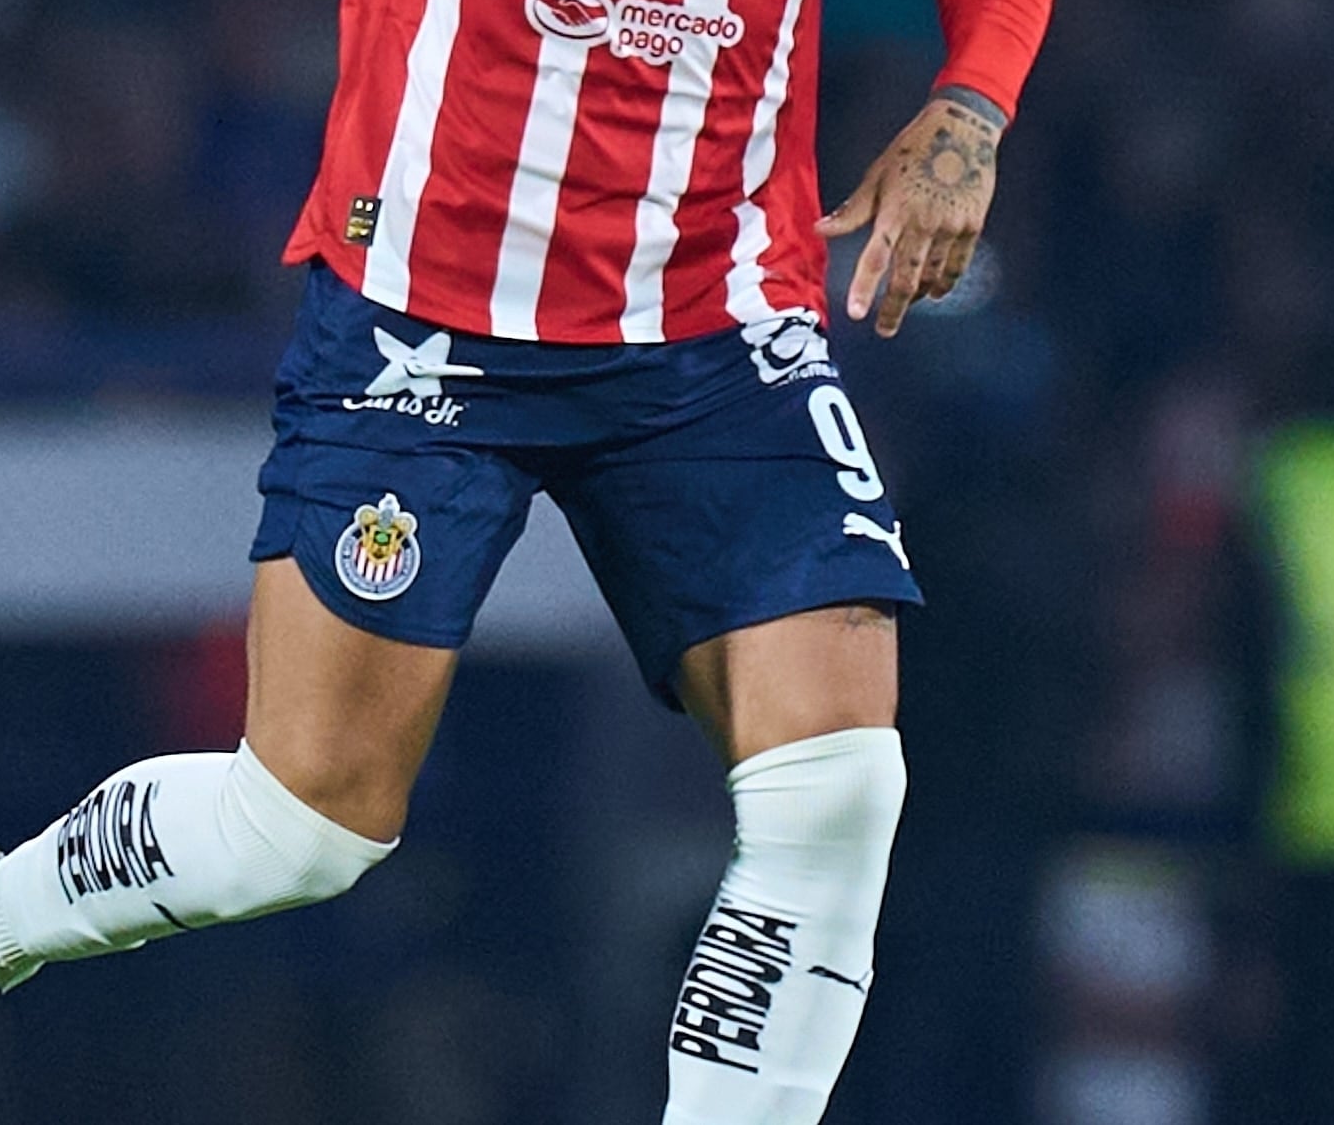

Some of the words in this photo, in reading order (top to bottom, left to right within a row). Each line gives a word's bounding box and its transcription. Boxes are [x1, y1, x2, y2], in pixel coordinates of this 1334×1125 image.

[617, 26, 683, 56] pago
[620, 4, 737, 39] mercado
[808, 385, 885, 501] 9
[671, 905, 797, 1074] PERDURA
